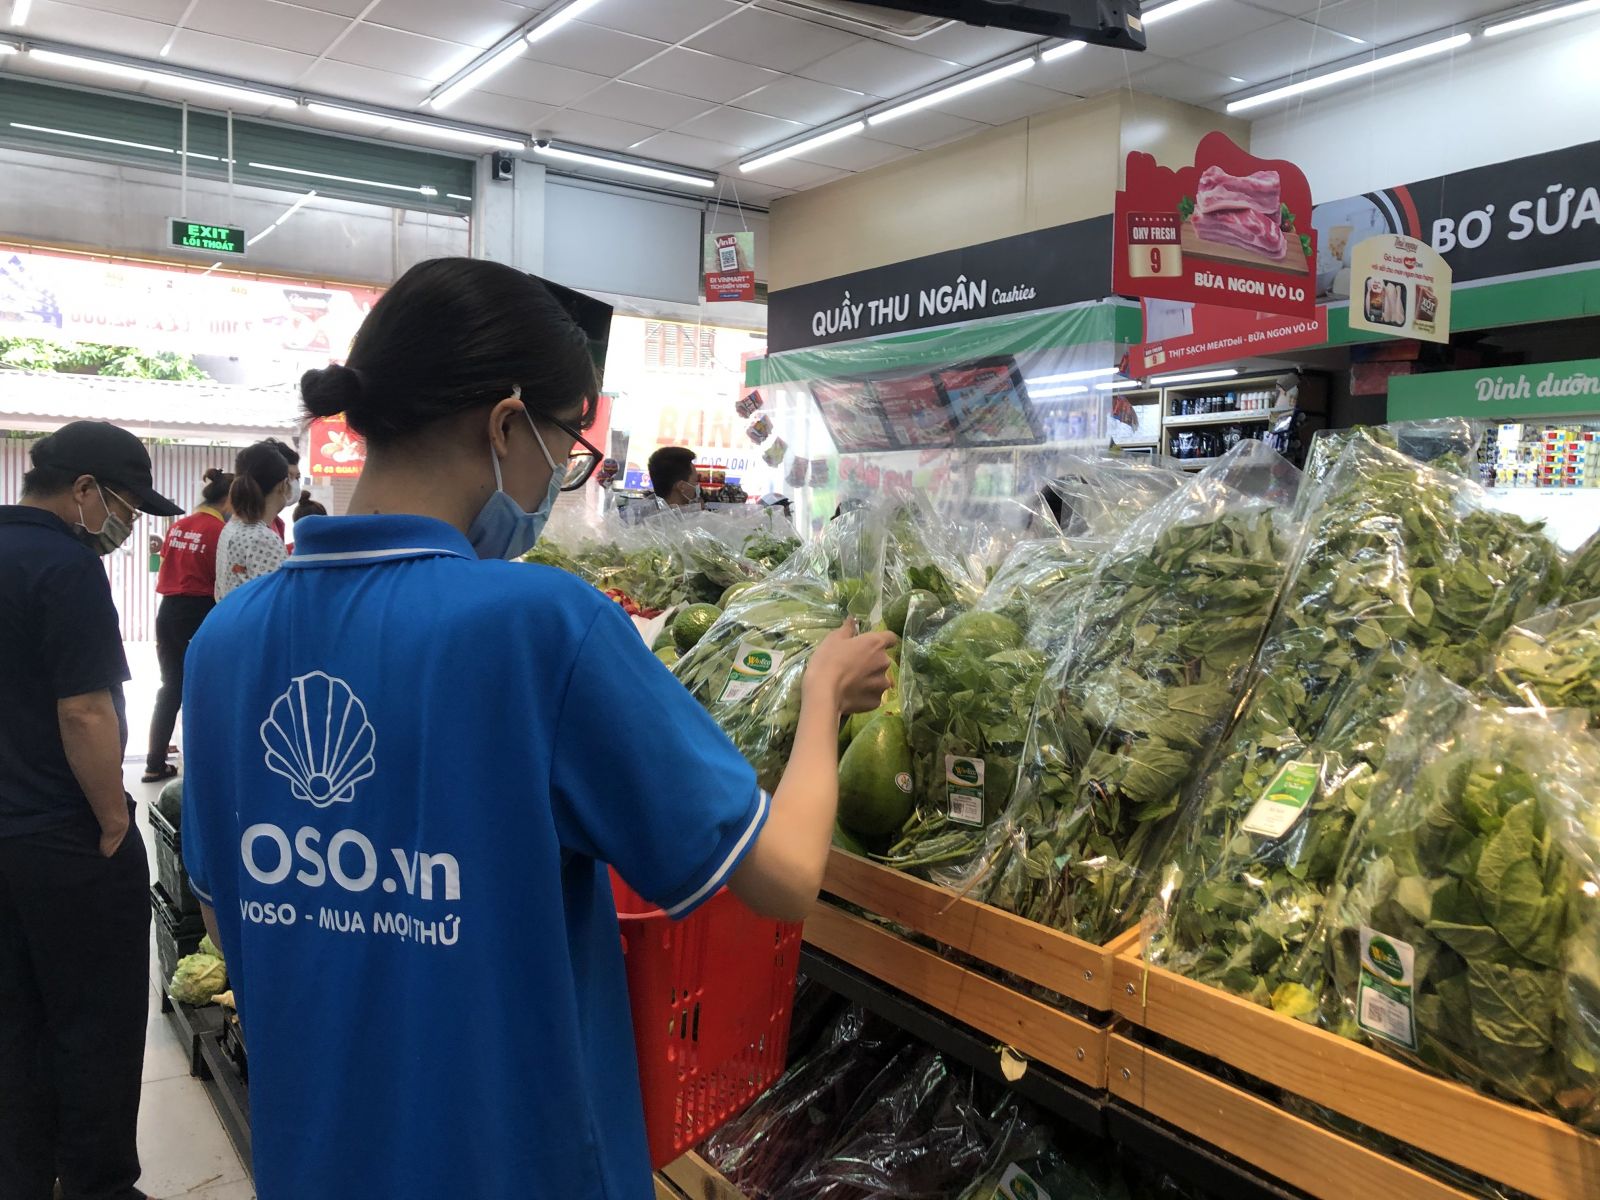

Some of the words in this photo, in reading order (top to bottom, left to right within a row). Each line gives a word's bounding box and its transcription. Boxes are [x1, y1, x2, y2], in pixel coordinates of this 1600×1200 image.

[188, 224, 229, 240] EXIT
[1432, 204, 1495, 254] BƠ
[1507, 183, 1600, 241] SỮA
[202, 239, 234, 251] THOÁT
[1133, 226, 1149, 240] OXY
[1150, 226, 1176, 240] FRESH
[1150, 247, 1161, 273] 9
[1228, 278, 1264, 295] NGON
[1289, 287, 1305, 302] LO
[812, 290, 863, 337] QUẦY
[867, 293, 910, 327] THU
[919, 274, 987, 318] NGÂN
[992, 284, 1036, 305] Cashies
[1168, 348, 1184, 360] THỊT
[1186, 343, 1206, 356] SẠCH
[1207, 338, 1243, 350] MEATDeli
[1248, 331, 1265, 343] BỮA
[1266, 326, 1292, 339] NGON
[1293, 322, 1305, 334] VÔ
[1307, 320, 1319, 331] LO
[1475, 374, 1531, 401] Dinh
[238, 821, 460, 900] OSO.vn
[240, 898, 296, 925] VOSO
[319, 907, 365, 933] MUA
[413, 913, 461, 946] THỨ
